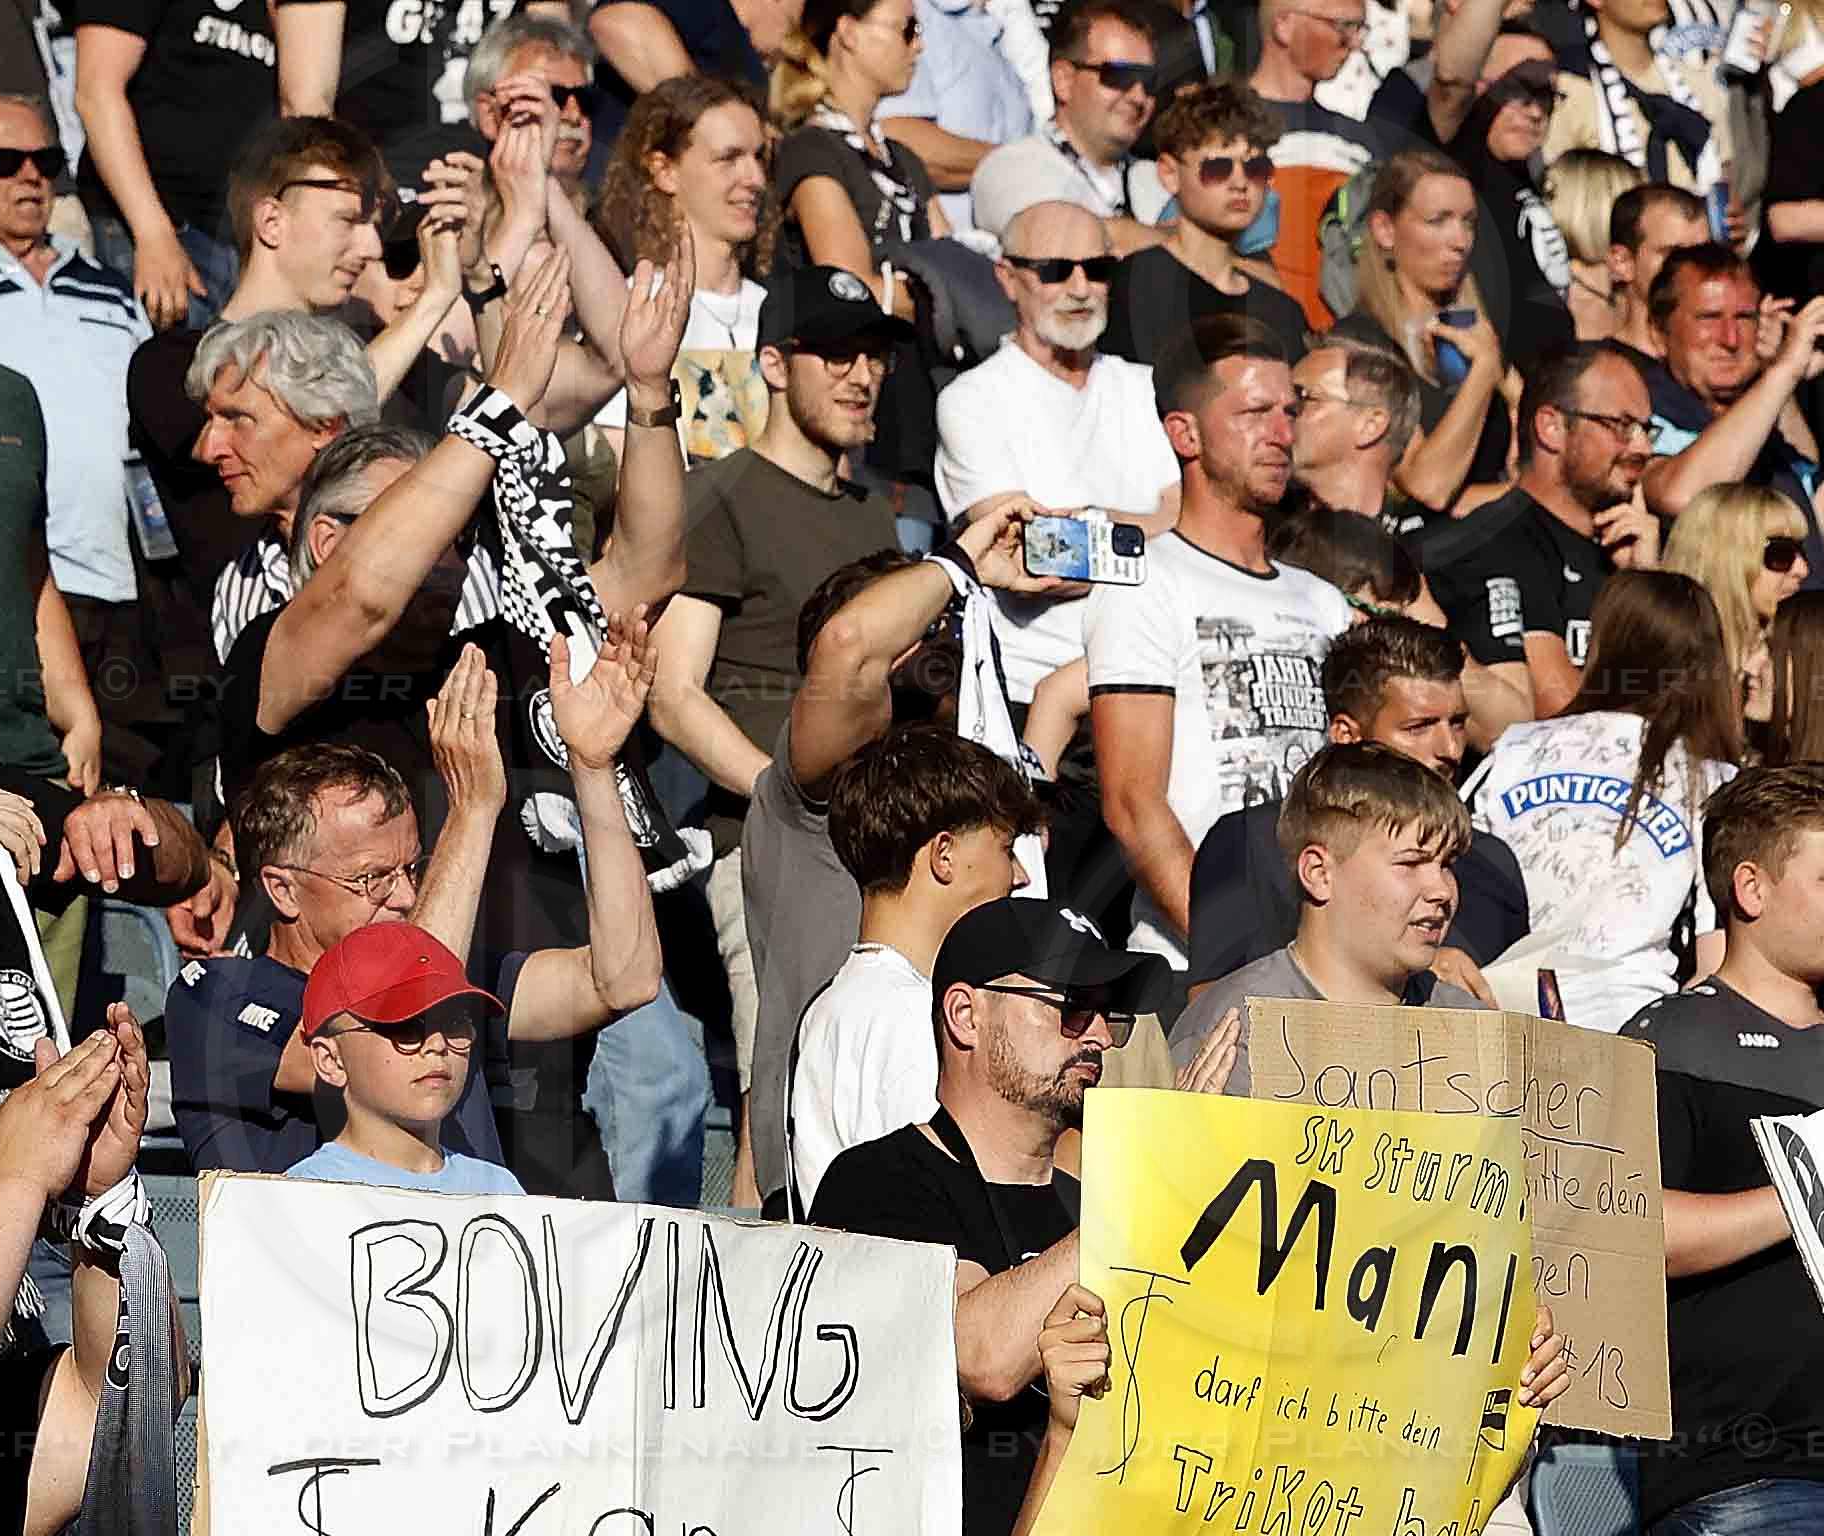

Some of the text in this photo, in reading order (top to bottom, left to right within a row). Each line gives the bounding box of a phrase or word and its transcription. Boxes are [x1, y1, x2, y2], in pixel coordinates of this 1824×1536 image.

[348, 1212, 862, 1425] BOVING
[1194, 1355, 1442, 1450] darf ich bitte dein
